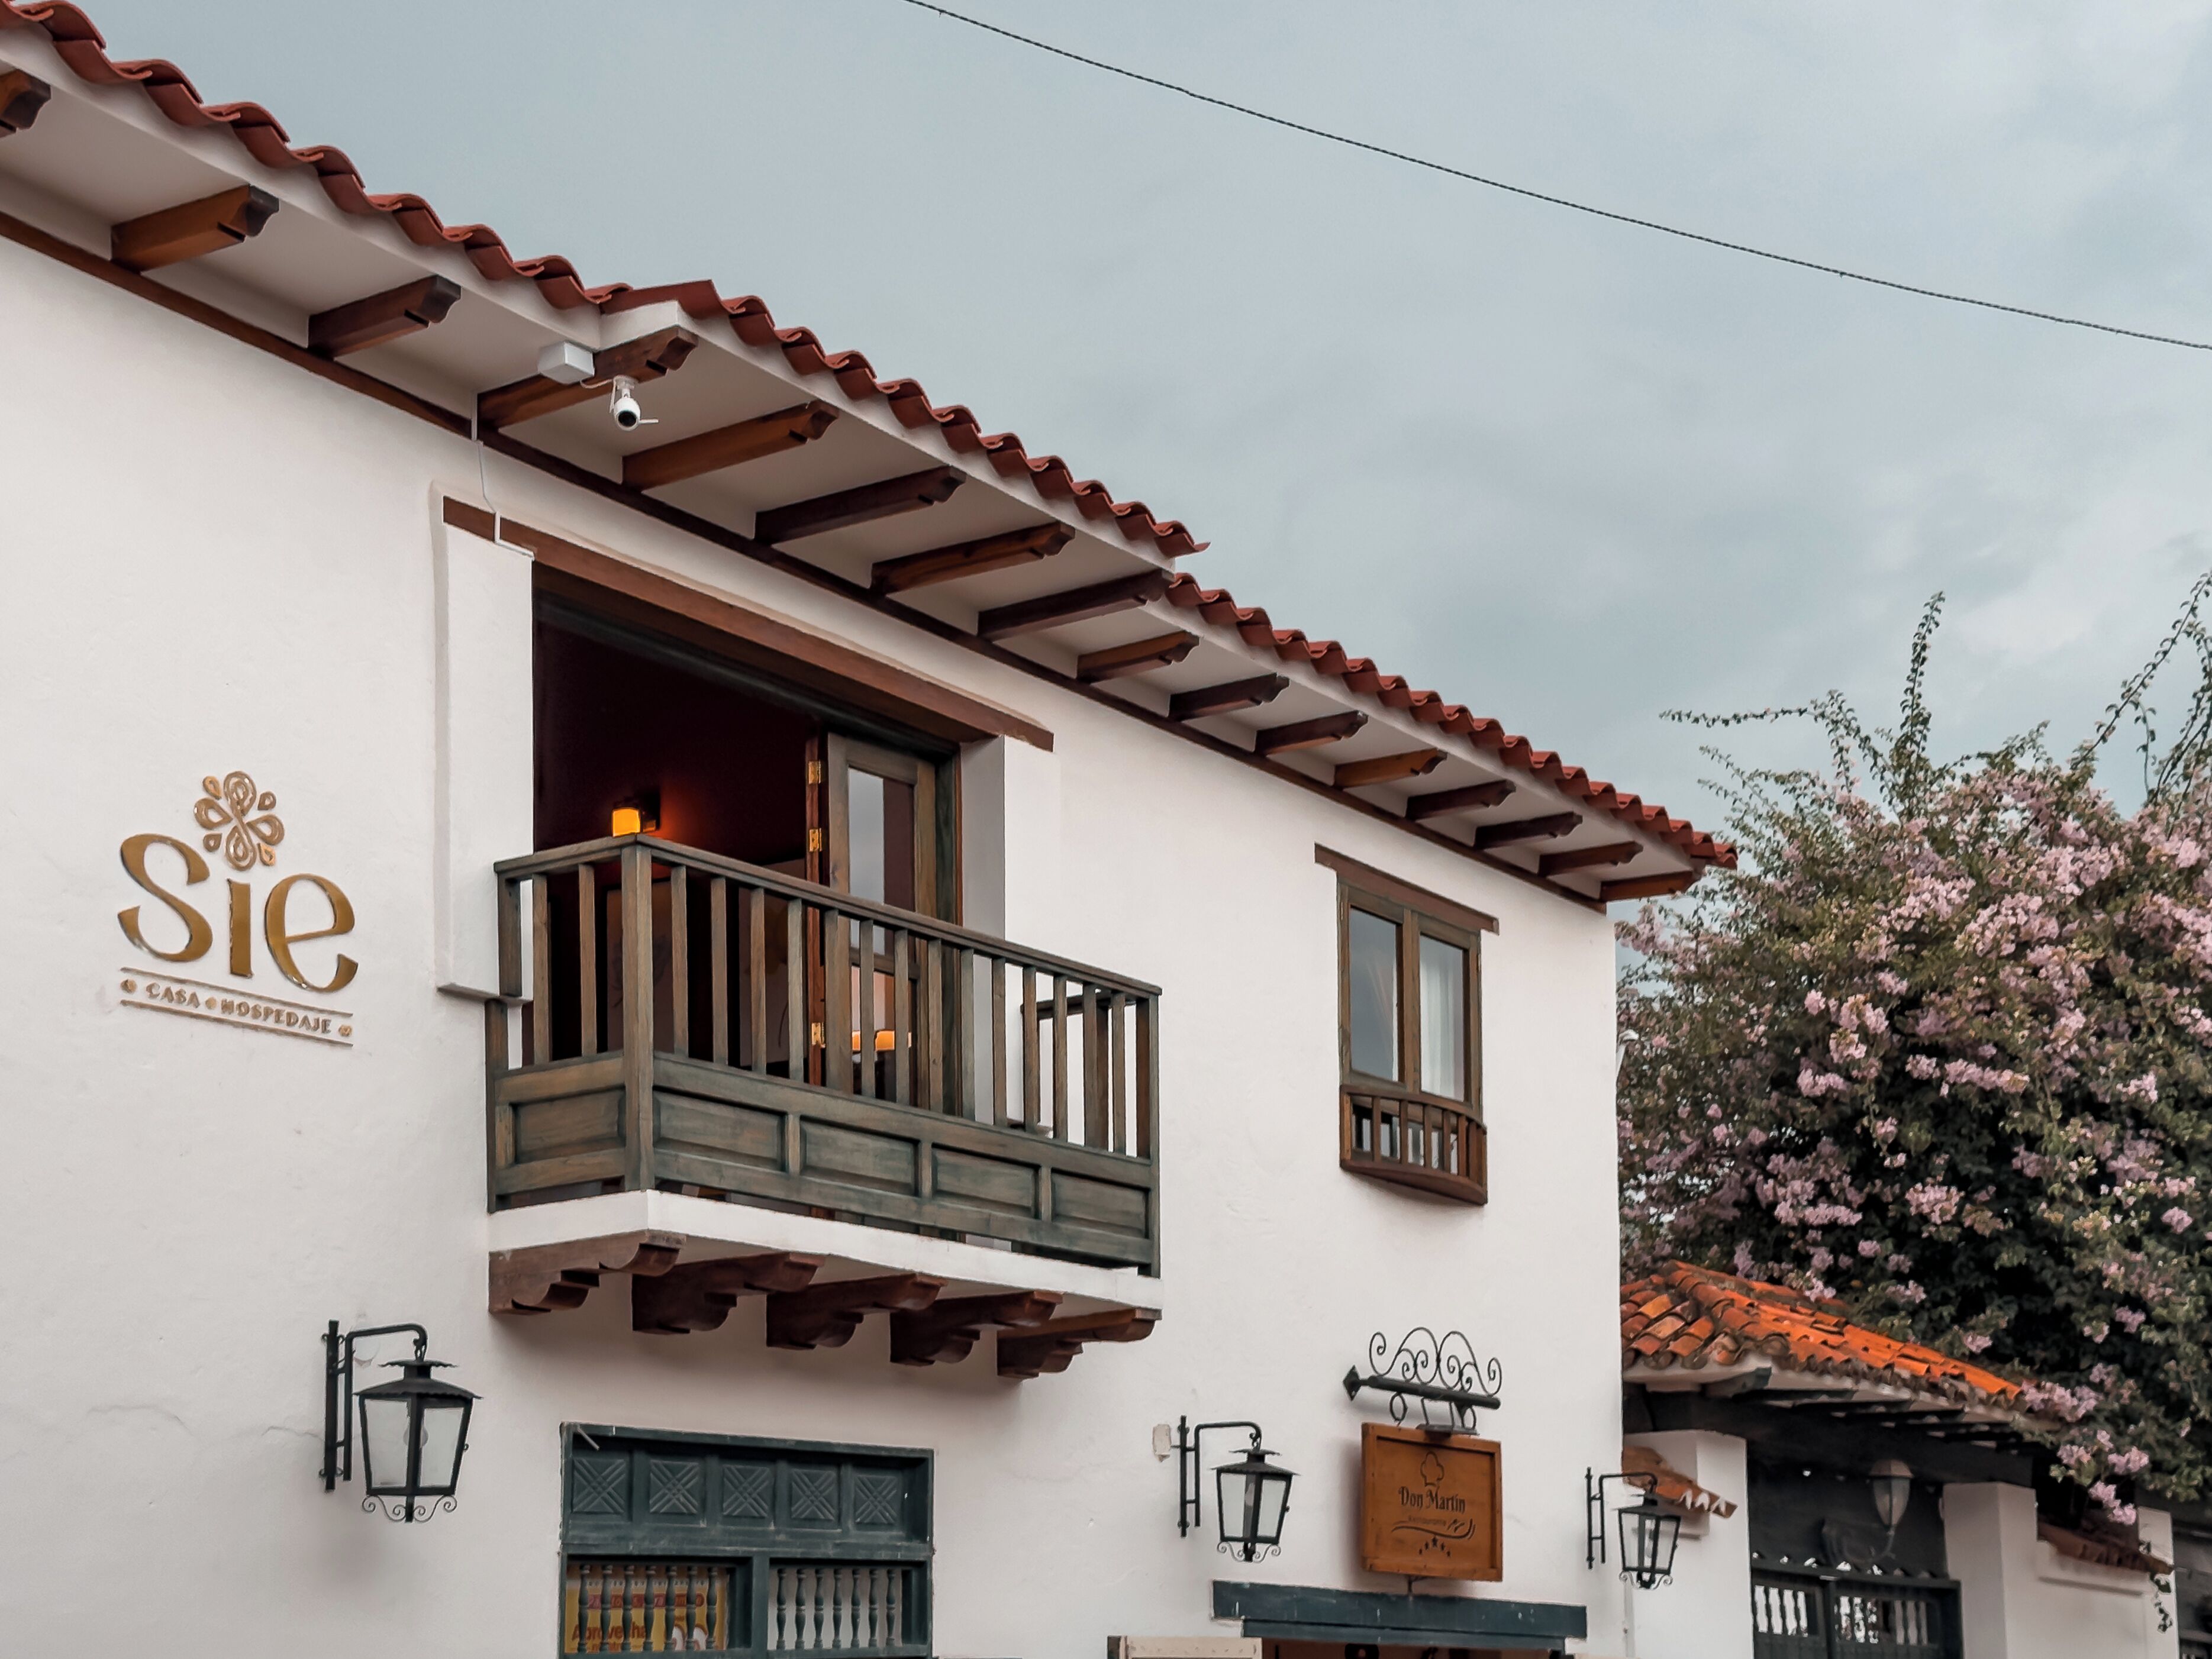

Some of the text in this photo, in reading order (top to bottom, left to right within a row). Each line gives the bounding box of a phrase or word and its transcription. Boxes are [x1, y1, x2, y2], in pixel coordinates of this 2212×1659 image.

[118, 833, 359, 993] Sie
[146, 982, 331, 1034] CASA HOSPEDAJE
[1398, 1486, 1423, 1510] Don
